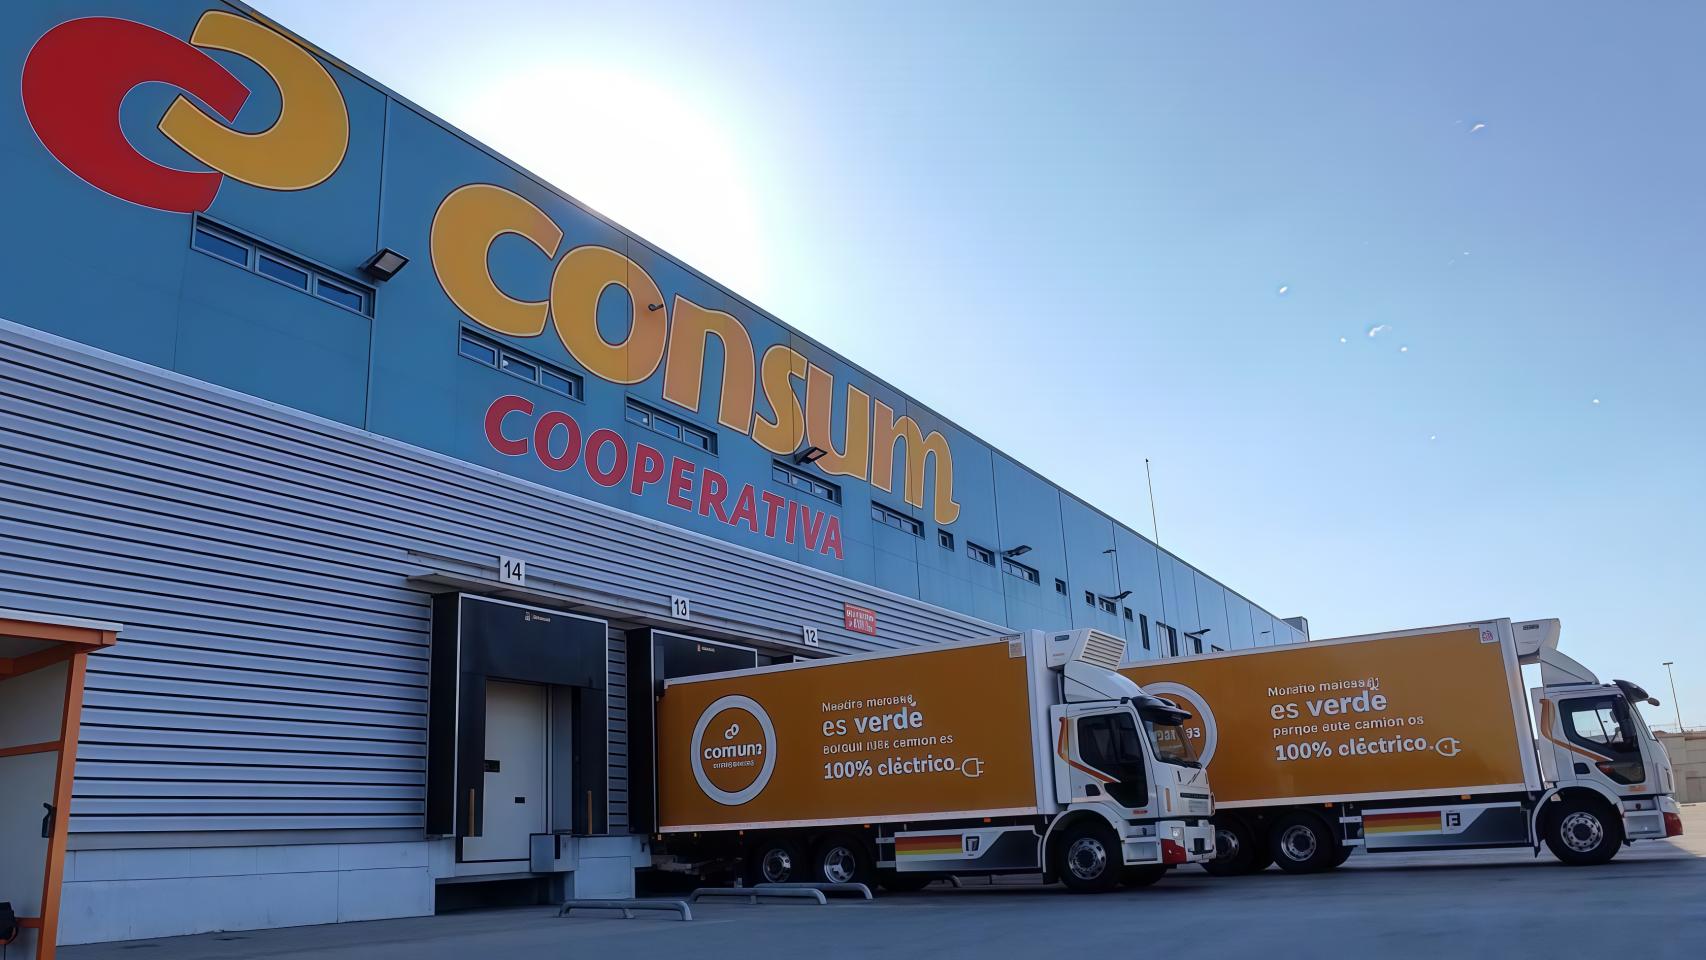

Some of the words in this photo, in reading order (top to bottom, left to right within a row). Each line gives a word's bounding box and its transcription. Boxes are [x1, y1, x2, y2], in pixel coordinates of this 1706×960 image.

[430, 183, 960, 525] consum
[484, 394, 845, 561] COOPERATIVA
[504, 560, 523, 581] 14
[674, 598, 687, 616] 13
[805, 629, 817, 644] 12
[1270, 702, 1299, 720] es
[1306, 690, 1388, 717] verde
[822, 719, 847, 737] es
[940, 735, 953, 744] es
[1275, 741, 1332, 761] 100%
[824, 759, 872, 780] 100%
